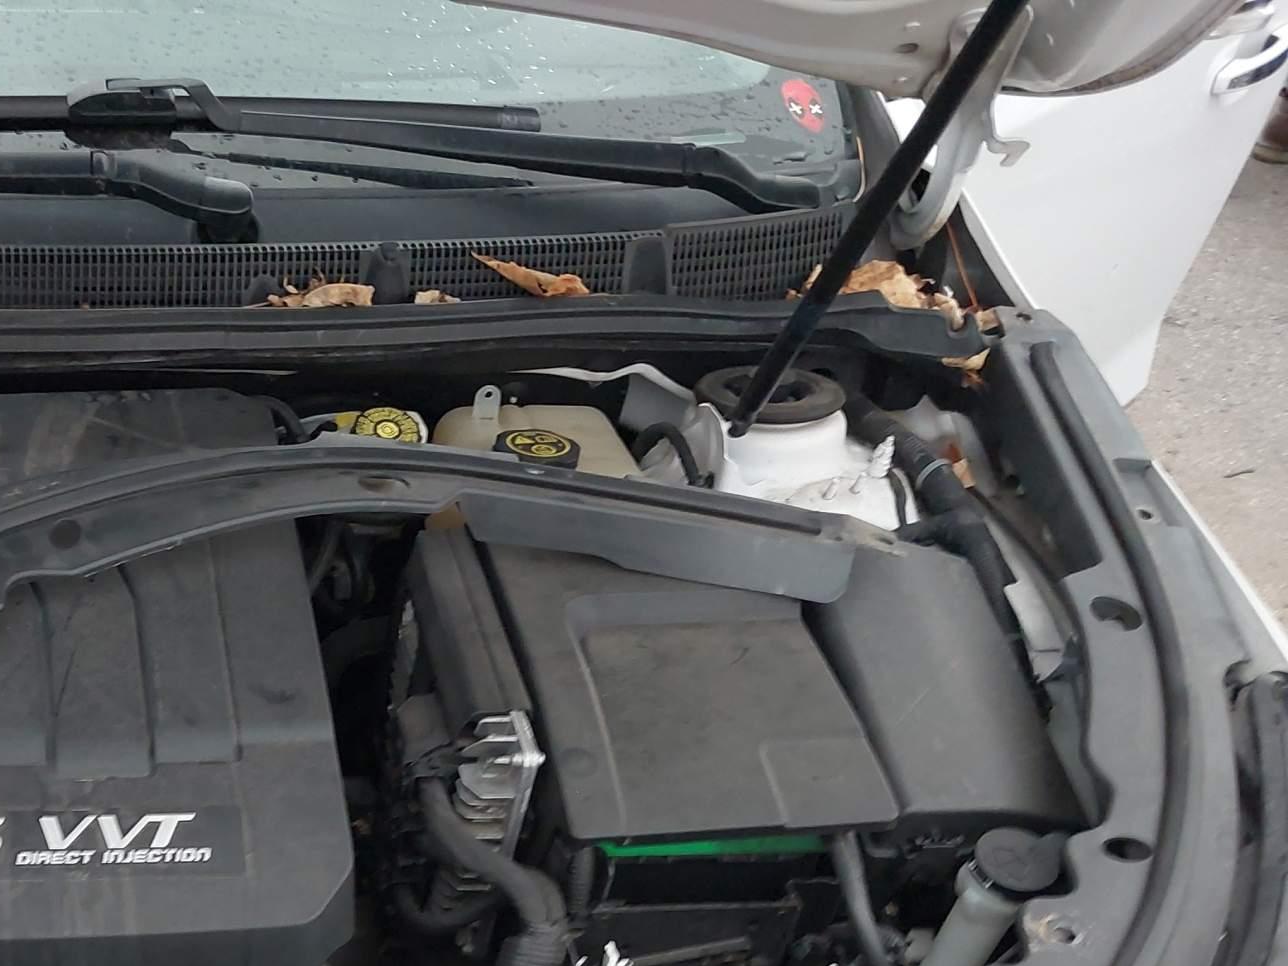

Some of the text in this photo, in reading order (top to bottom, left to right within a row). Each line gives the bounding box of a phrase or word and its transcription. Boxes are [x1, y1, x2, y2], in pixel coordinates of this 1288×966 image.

[38, 812, 197, 850] VVT
[14, 846, 213, 866] DIRECT INJECTION
